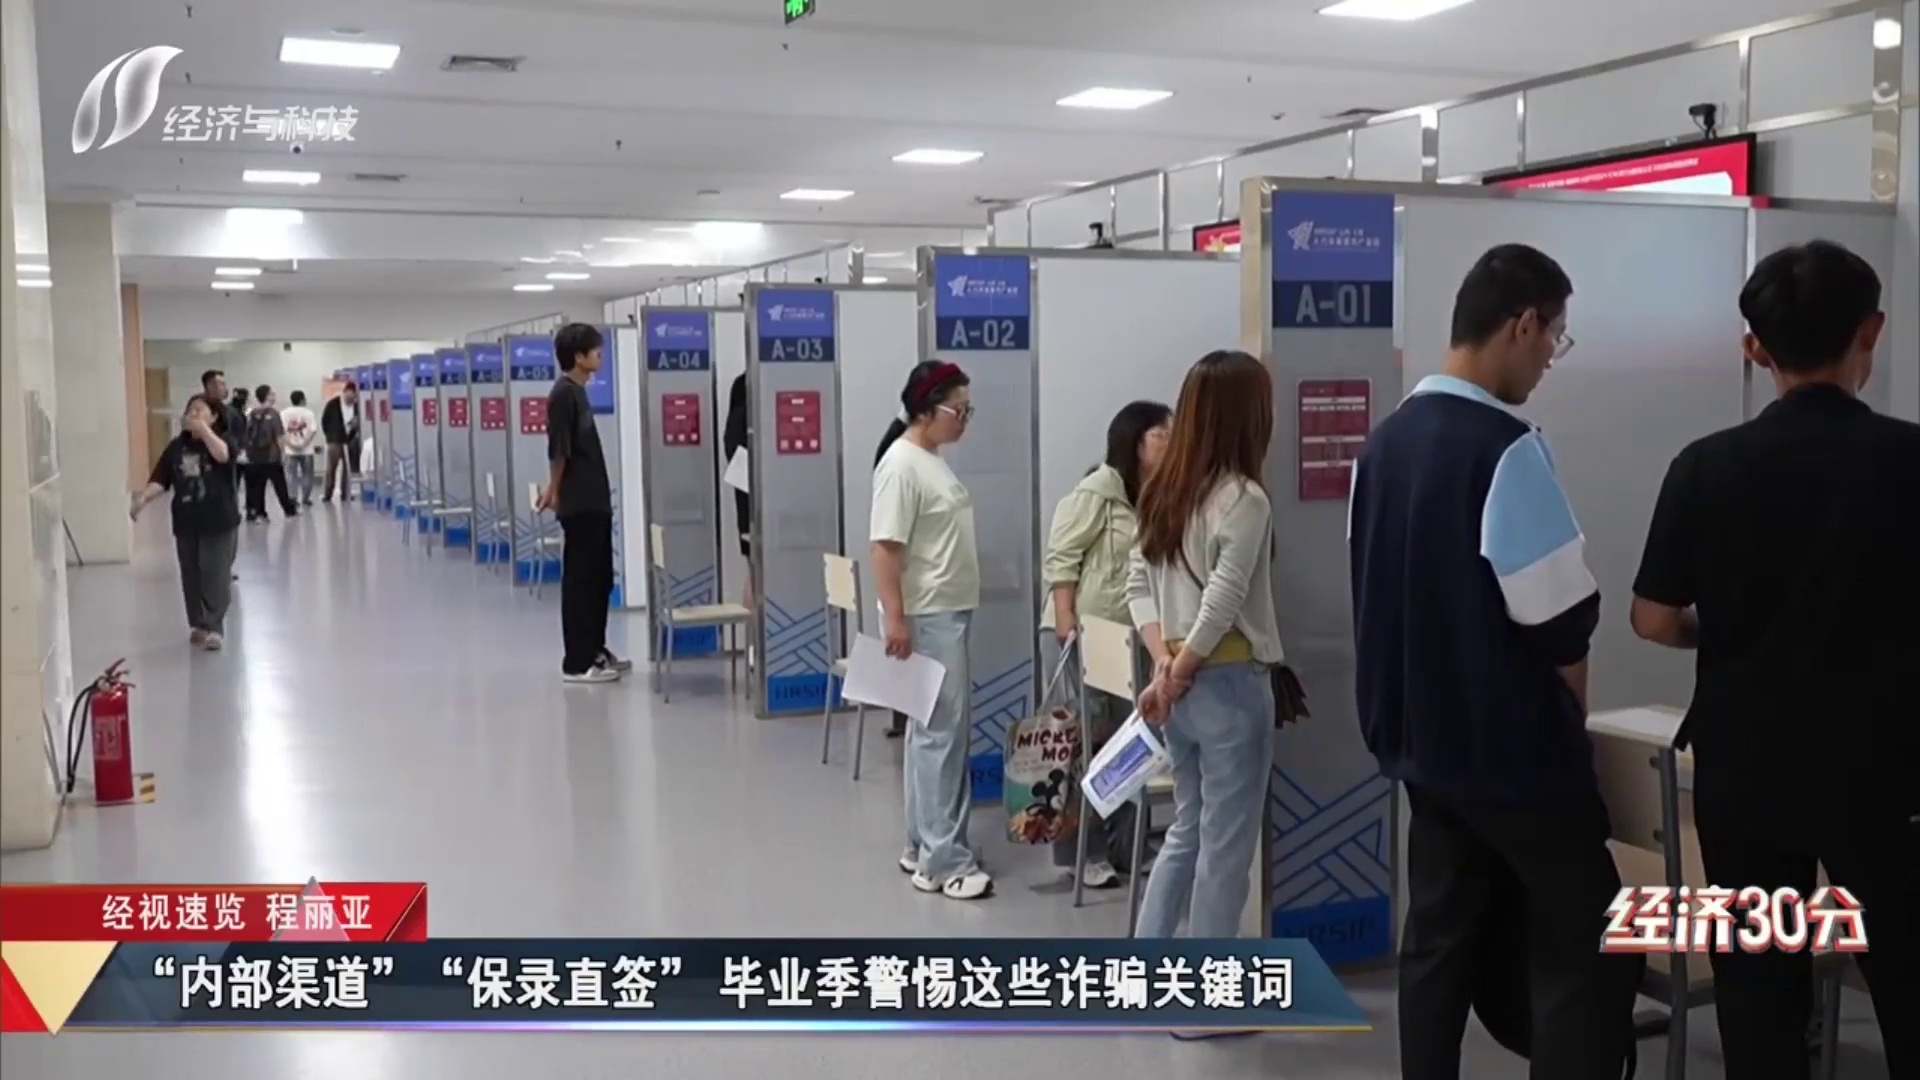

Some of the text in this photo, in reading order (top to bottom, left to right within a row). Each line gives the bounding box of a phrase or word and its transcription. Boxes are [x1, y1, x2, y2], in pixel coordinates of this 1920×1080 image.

[1296, 283, 1371, 323] A-01
[951, 319, 1016, 347] A-02
[657, 351, 700, 369] A-04
[771, 338, 823, 360] A-03
[517, 366, 549, 379] A-05
